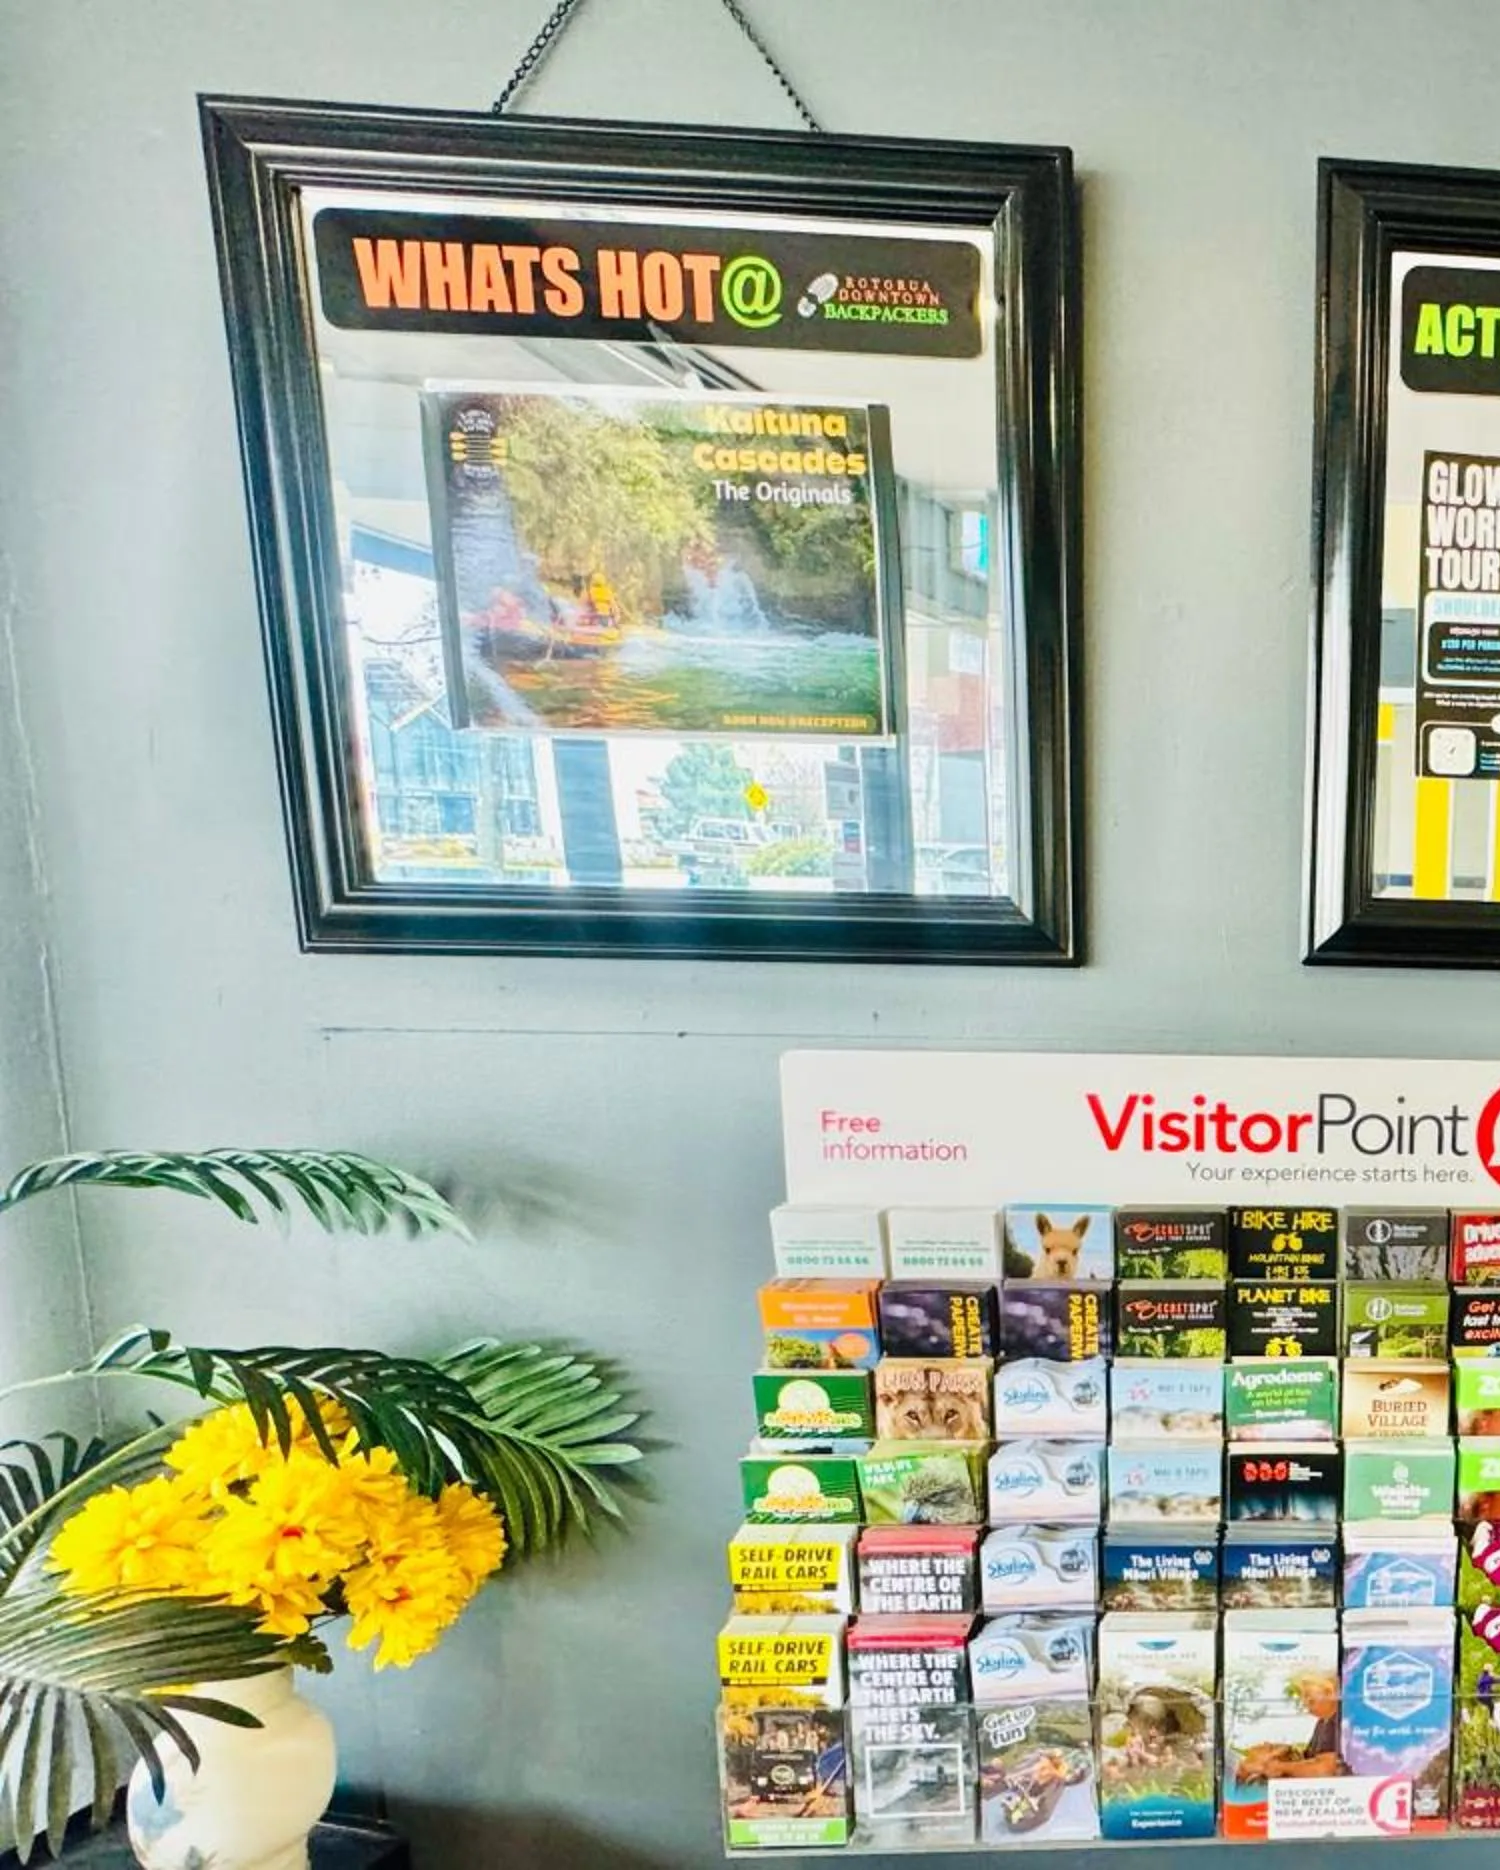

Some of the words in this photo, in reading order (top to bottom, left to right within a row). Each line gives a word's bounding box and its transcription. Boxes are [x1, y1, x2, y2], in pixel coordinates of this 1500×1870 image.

[352, 236, 583, 318] WHATS
[846, 276, 931, 292] ROTORUA
[839, 288, 940, 305] DOWNTOWN
[824, 303, 949, 325] BACKPACKERS
[702, 403, 846, 438] Kaituna
[693, 443, 867, 476] Cascades
[713, 480, 750, 501] The
[755, 481, 852, 508] Originals
[1425, 548, 1500, 591] TOUR
[820, 1110, 881, 1134] Free
[1085, 1092, 1469, 1156] VisitorPoint
[822, 1137, 968, 1162] information
[1187, 1161, 1234, 1182] Your
[1241, 1162, 1356, 1184] experience
[1361, 1164, 1417, 1184] starts
[1423, 1164, 1474, 1184] here.
[1242, 1211, 1286, 1231] BIKE
[1292, 1211, 1336, 1232] HIRE
[1238, 1289, 1296, 1304] PLANET
[1299, 1289, 1331, 1305] BIKE
[1468, 1301, 1495, 1314] Get
[966, 1295, 984, 1356] CREATE
[1082, 1294, 1099, 1354] CREATE
[1463, 1314, 1490, 1327] fast
[1232, 1369, 1323, 1391] Agrodome
[1003, 1386, 1049, 1405] Skyline
[1372, 1400, 1427, 1413] BURIED
[1368, 1414, 1428, 1427] VILLAGE
[994, 1469, 1043, 1489] Skyline
[866, 1558, 932, 1576] WHERE
[935, 1558, 967, 1576] THE
[988, 1557, 1036, 1579] Skyline
[1130, 1555, 1152, 1567] The
[1155, 1555, 1191, 1569] Living
[1249, 1553, 1271, 1567] The
[1273, 1553, 1309, 1568] Living
[741, 1566, 779, 1580] RAIL
[786, 1565, 829, 1580] CARS
[1159, 1567, 1199, 1582] Village
[1276, 1565, 1317, 1581] Village
[869, 1576, 937, 1594] CENTRE
[939, 1576, 961, 1593] OF
[869, 1595, 905, 1612] THE
[908, 1595, 963, 1612] EARTH
[729, 1659, 768, 1673] RAIL
[775, 1659, 818, 1674] CARS
[857, 1653, 924, 1670] WHERE
[927, 1653, 959, 1670] THE
[976, 1656, 1026, 1674] Skyline
[860, 1671, 928, 1688] CENTRE
[930, 1671, 954, 1687] OF
[861, 1688, 897, 1704] THE
[900, 1687, 956, 1704] EARTH
[864, 1707, 920, 1723] MEETS
[864, 1724, 899, 1741] THE
[901, 1723, 940, 1741] SKY.
[1275, 1788, 1335, 1798] DISCOVER
[1275, 1798, 1297, 1807] THE
[1302, 1798, 1331, 1806] BEST
[1334, 1797, 1350, 1806] OF
[1308, 1806, 1364, 1817] ZEALAND
